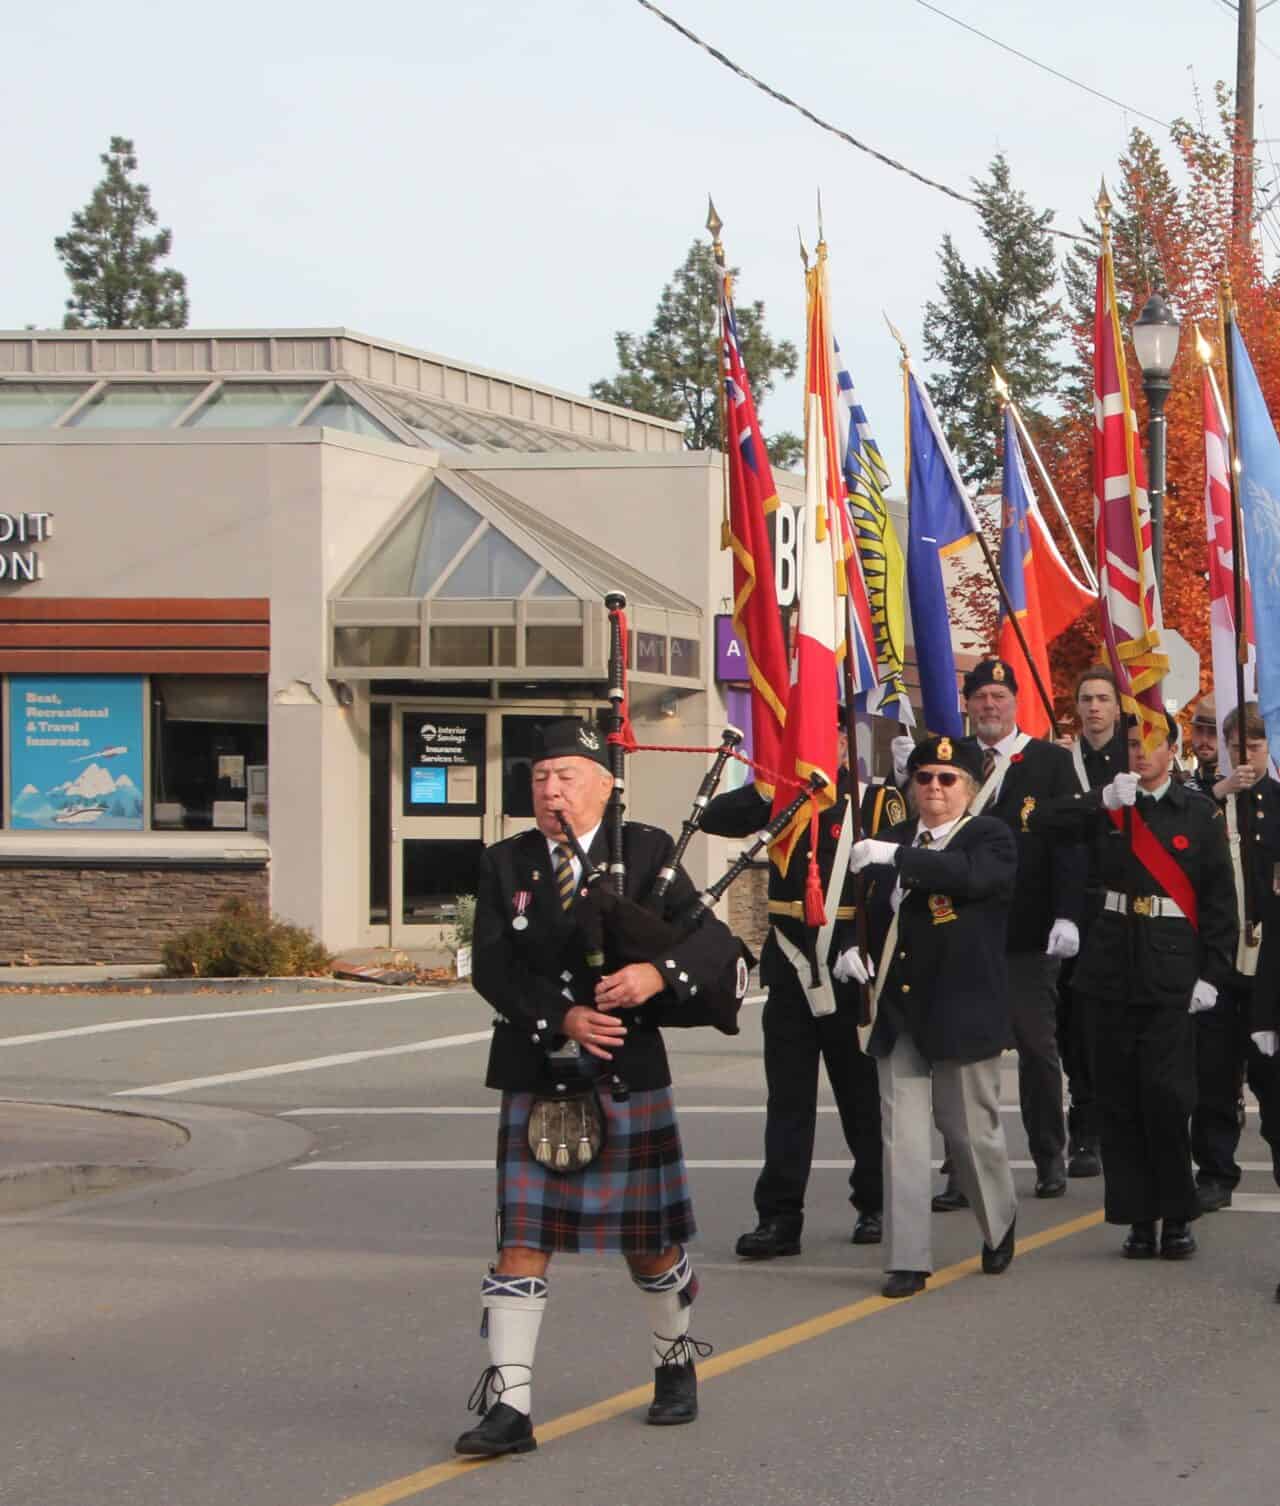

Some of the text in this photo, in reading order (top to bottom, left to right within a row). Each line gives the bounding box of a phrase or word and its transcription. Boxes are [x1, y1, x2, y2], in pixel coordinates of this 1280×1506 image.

[25, 707, 109, 718] Recreational
[26, 721, 79, 732] & Travel
[438, 726, 466, 735] Interior
[26, 736, 89, 747] Insurance
[437, 734, 465, 744] Savings
[426, 745, 462, 753] Insurance
[420, 754, 452, 763] Services
